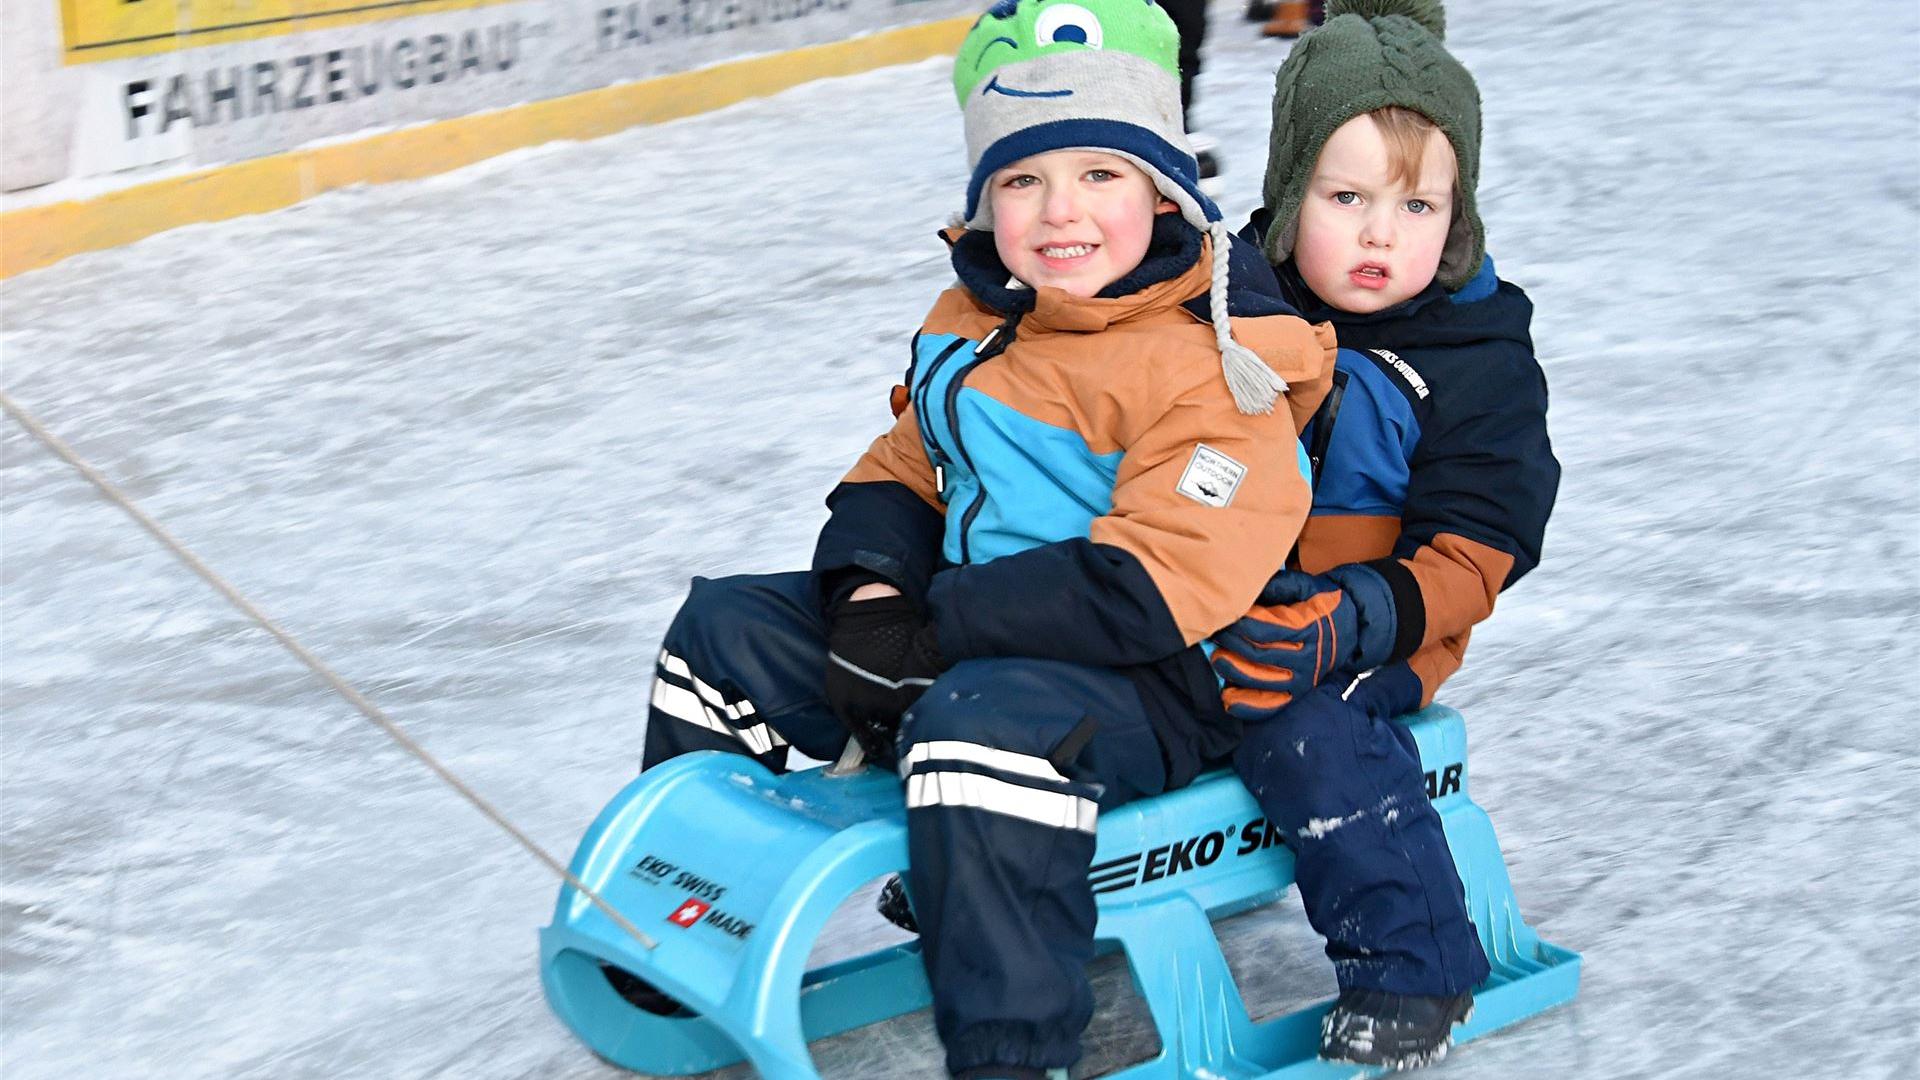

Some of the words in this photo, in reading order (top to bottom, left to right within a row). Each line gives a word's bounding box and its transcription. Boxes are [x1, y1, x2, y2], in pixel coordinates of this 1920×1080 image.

[122, 20, 522, 140] FAHRZEUGBAU
[1195, 462, 1234, 486] OUTDOOR
[1199, 453, 1238, 478] NORTHERN
[672, 871, 727, 901] SWISS
[704, 909, 755, 940] MADE
